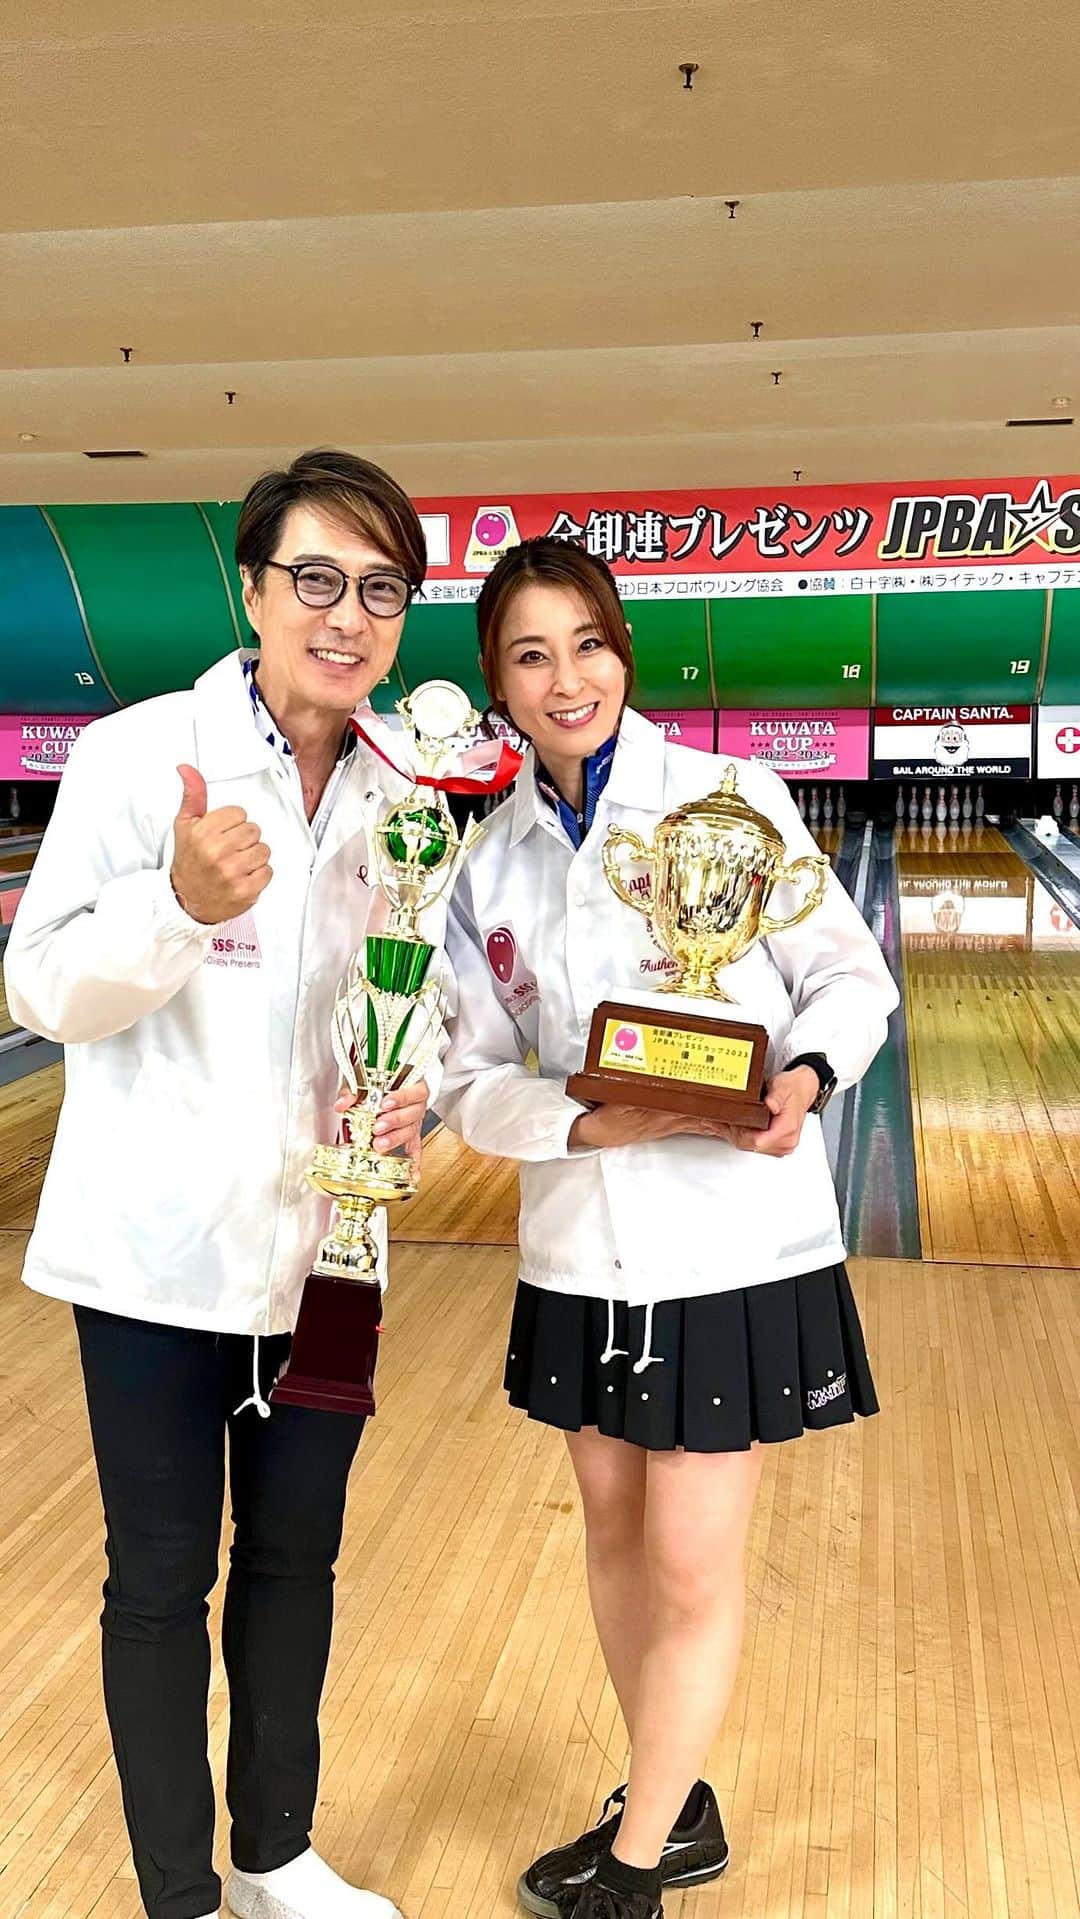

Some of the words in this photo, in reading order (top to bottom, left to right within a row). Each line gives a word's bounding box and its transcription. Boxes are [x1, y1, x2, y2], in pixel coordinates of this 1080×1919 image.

[681, 666, 699, 680] 17
[841, 664, 861, 679] 18
[1010, 659, 1031, 674] 19
[74, 672, 95, 685] 13
[892, 707, 957, 721] CAPTAIN
[959, 705, 1014, 720] SANTA.
[749, 721, 838, 736] KUWATA
[772, 737, 814, 752] CUP
[893, 766, 913, 775] SAIL
[915, 766, 955, 775] AROUND
[956, 766, 974, 775] THE
[976, 765, 1012, 774] WORLD
